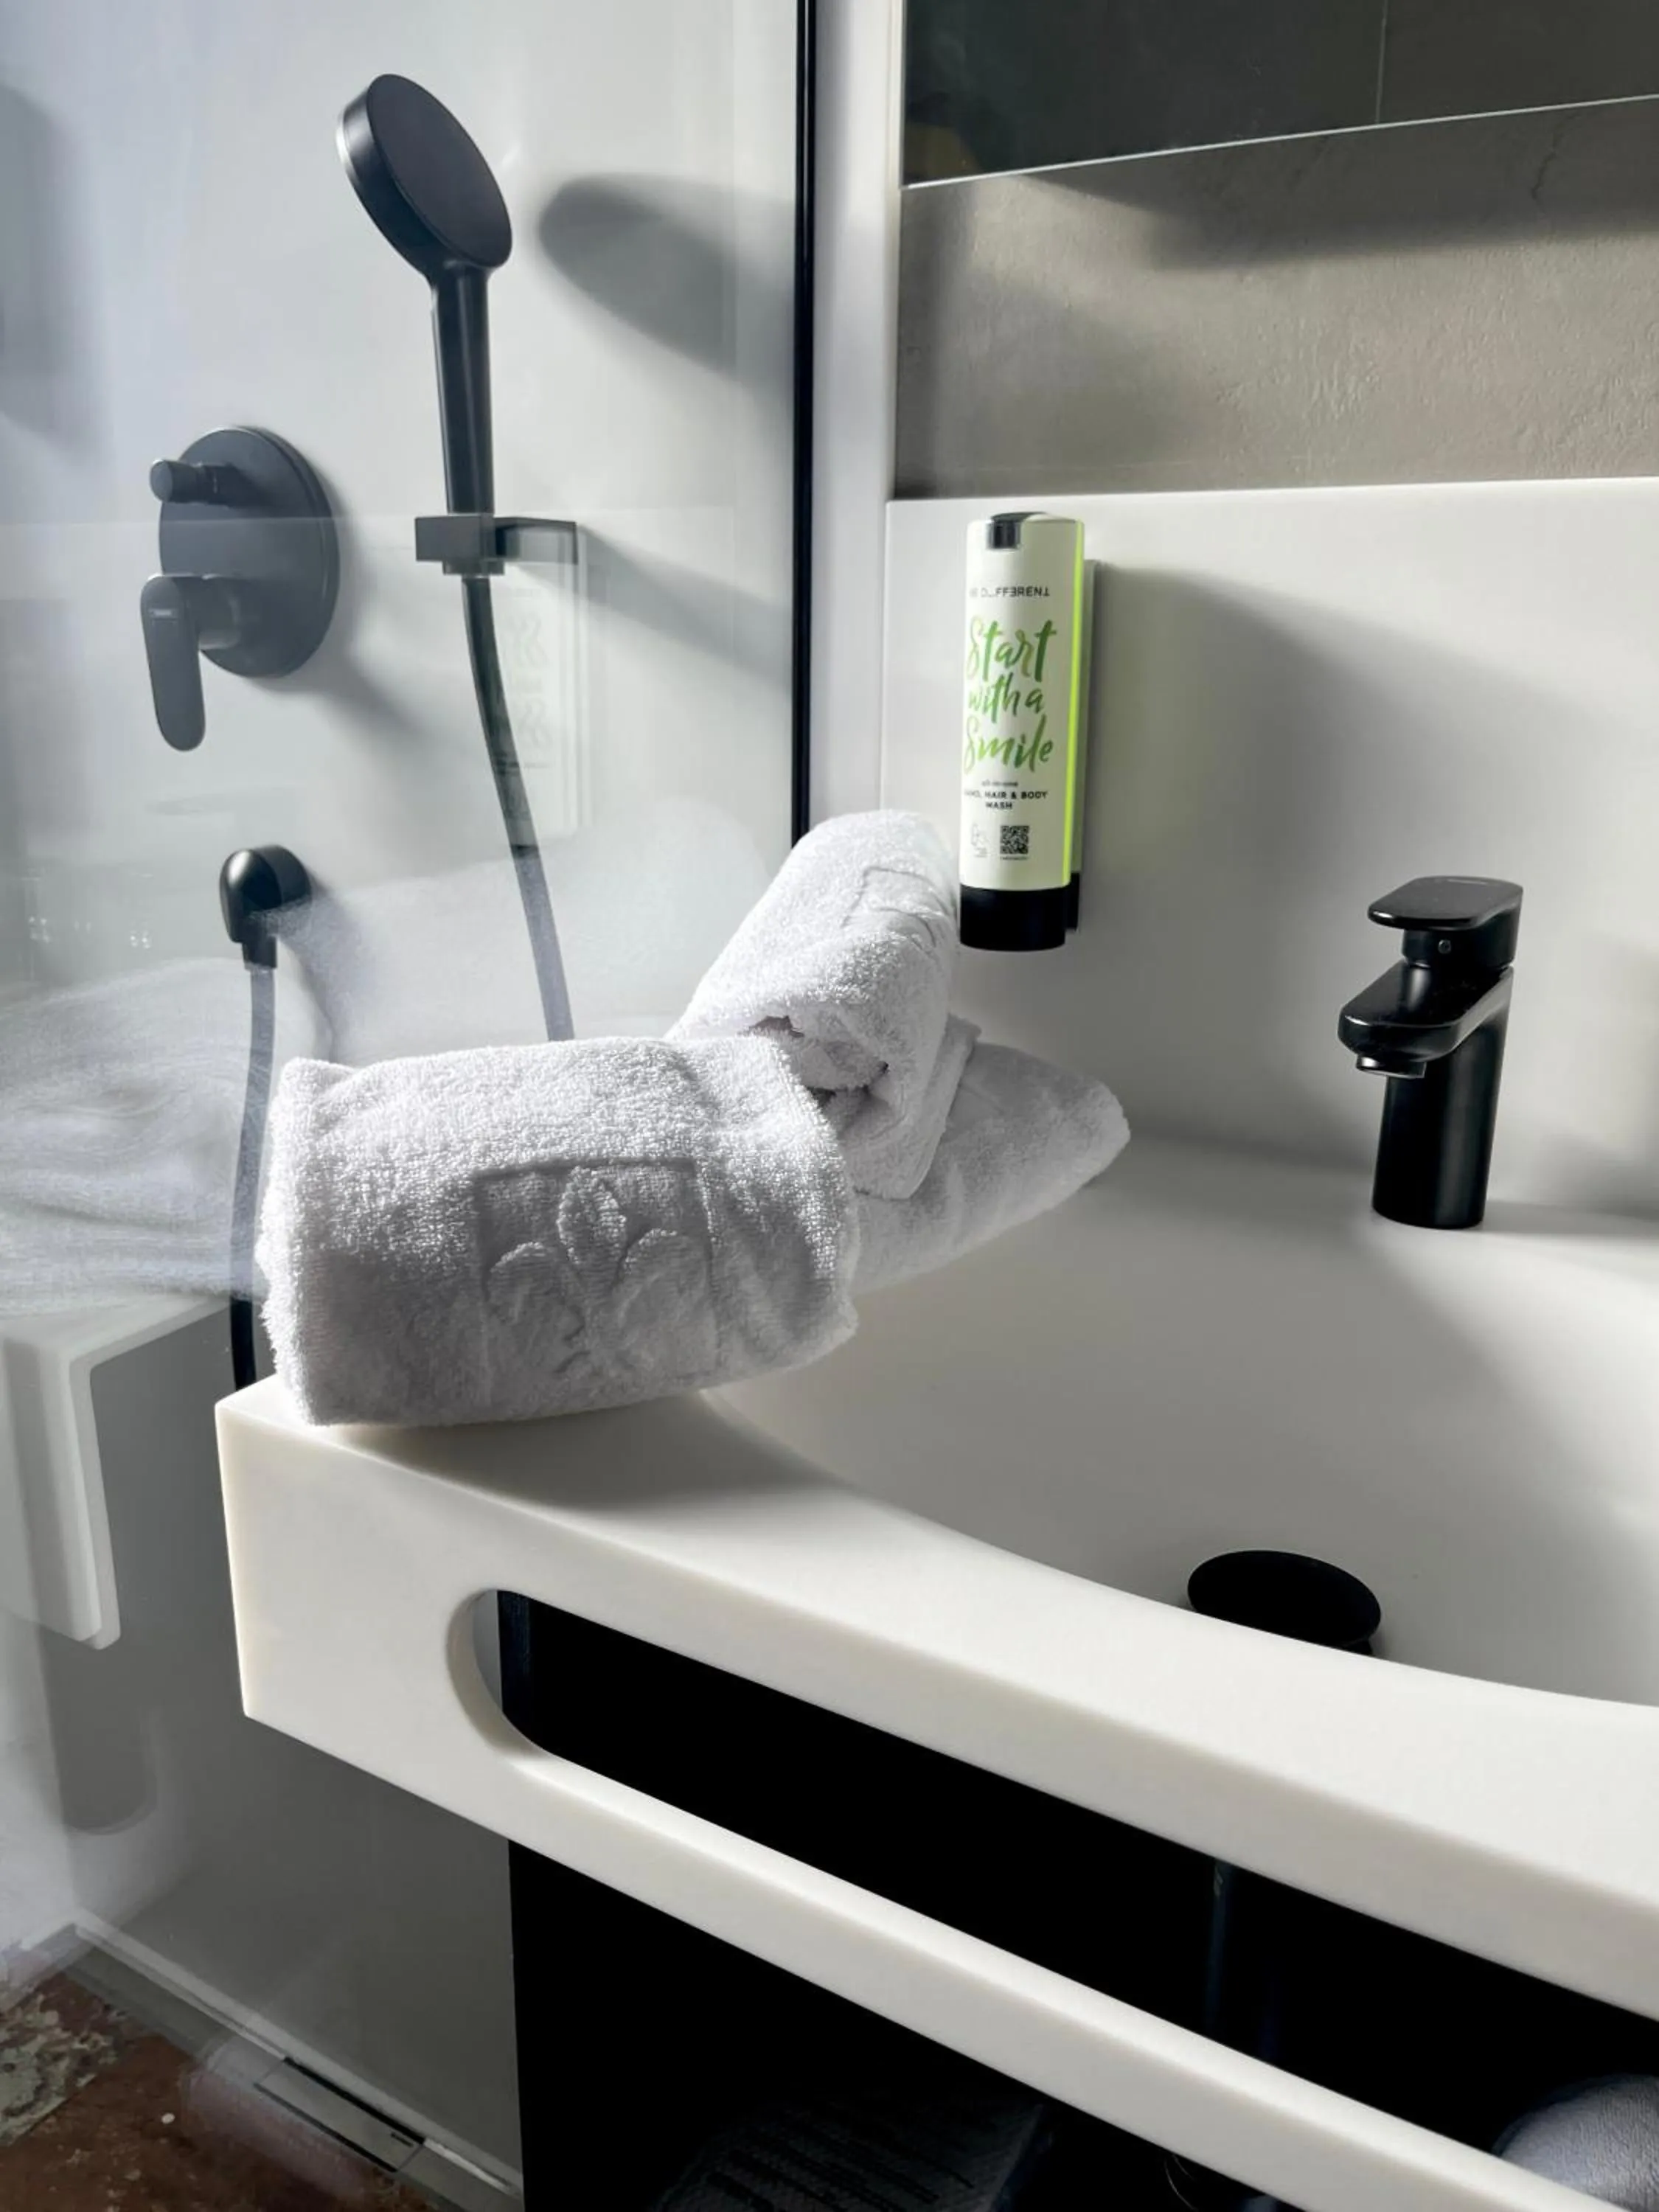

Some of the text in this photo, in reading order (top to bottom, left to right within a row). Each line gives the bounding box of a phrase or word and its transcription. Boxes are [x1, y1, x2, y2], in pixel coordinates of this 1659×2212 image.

[967, 615, 1057, 683] Start
[968, 672, 1046, 723] with a
[964, 714, 1054, 775] Smile
[984, 790, 1007, 800] HAIR
[1011, 790, 1018, 800] &
[1020, 790, 1048, 800] BODY
[985, 801, 1013, 810] WASH
